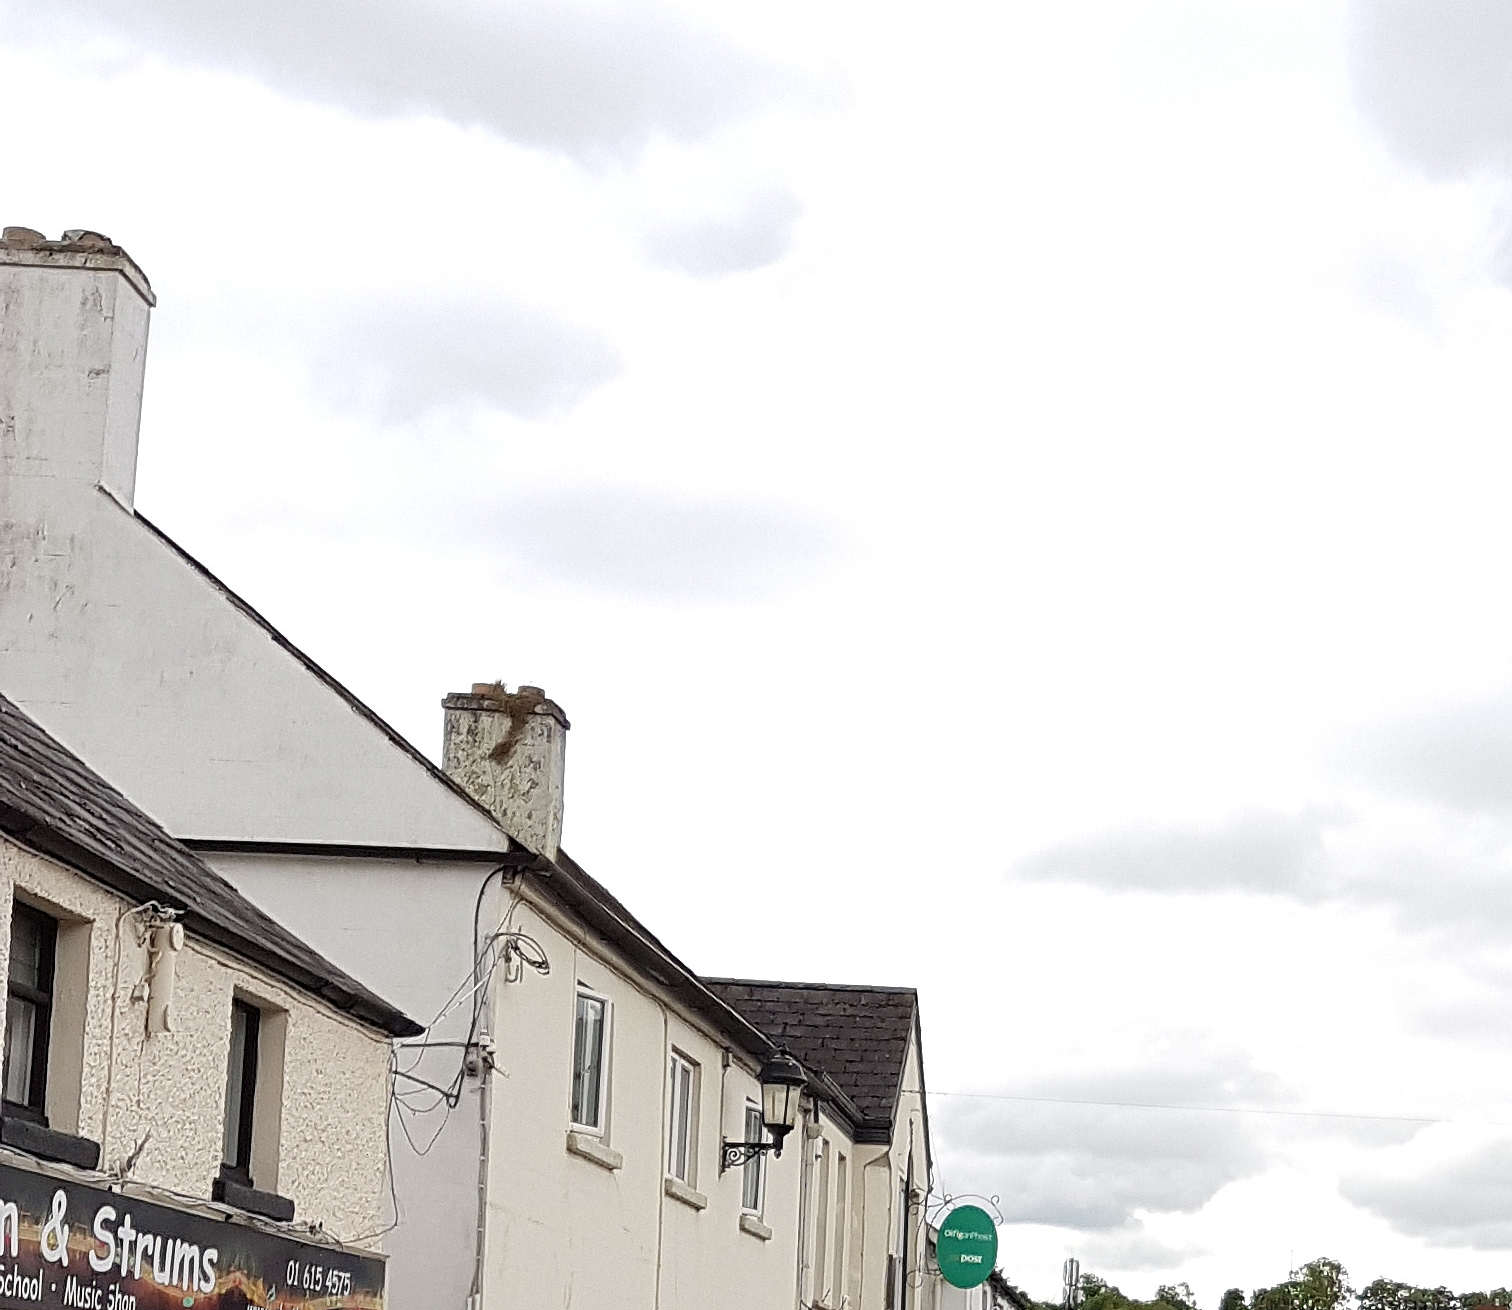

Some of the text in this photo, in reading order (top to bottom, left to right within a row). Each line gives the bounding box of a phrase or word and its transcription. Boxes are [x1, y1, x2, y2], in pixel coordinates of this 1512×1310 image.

[41, 1189, 70, 1267] &
[88, 1205, 219, 1294] Strums
[63, 1275, 102, 1310] Music
[286, 1260, 351, 1296] 01 615 4575
